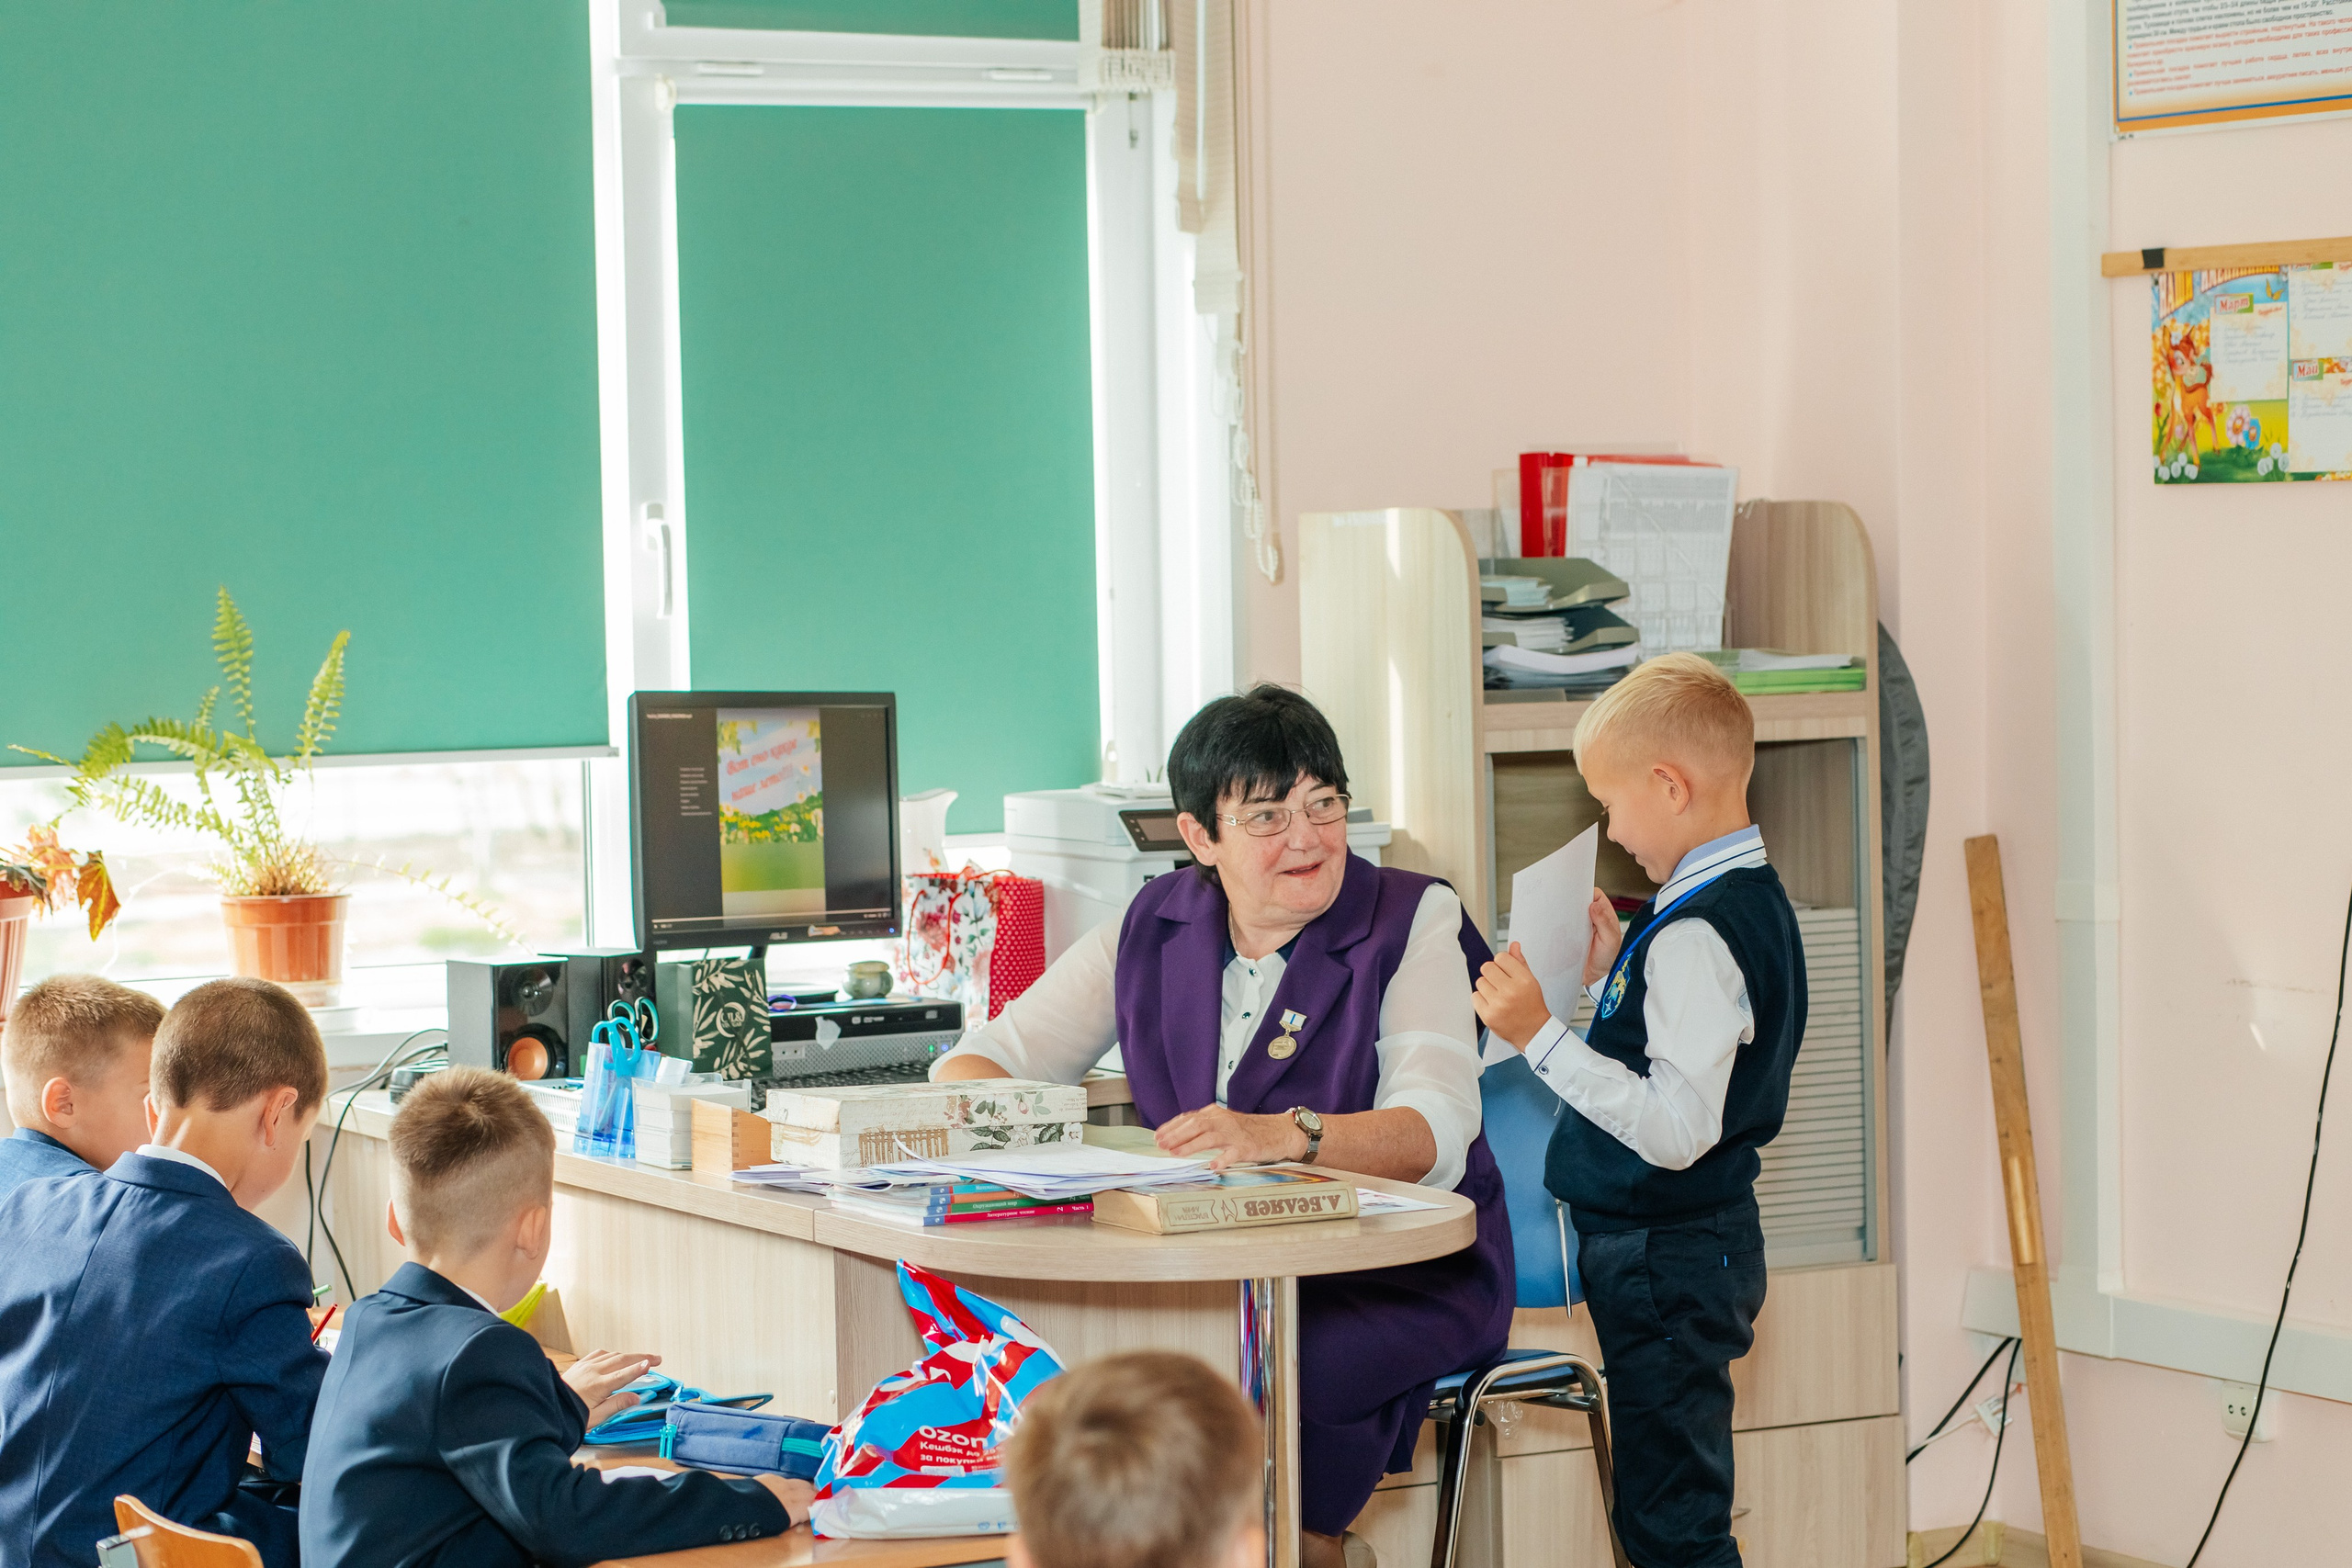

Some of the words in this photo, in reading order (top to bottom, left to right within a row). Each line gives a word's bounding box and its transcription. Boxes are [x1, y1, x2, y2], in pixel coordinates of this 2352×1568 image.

[2220, 298, 2248, 312] Март
[2297, 362, 2318, 378] Май
[972, 1201, 1007, 1210] Окружающий
[919, 1425, 989, 1449] ozon
[920, 1441, 964, 1455] Кешбэк
[935, 1455, 984, 1465] покупки
